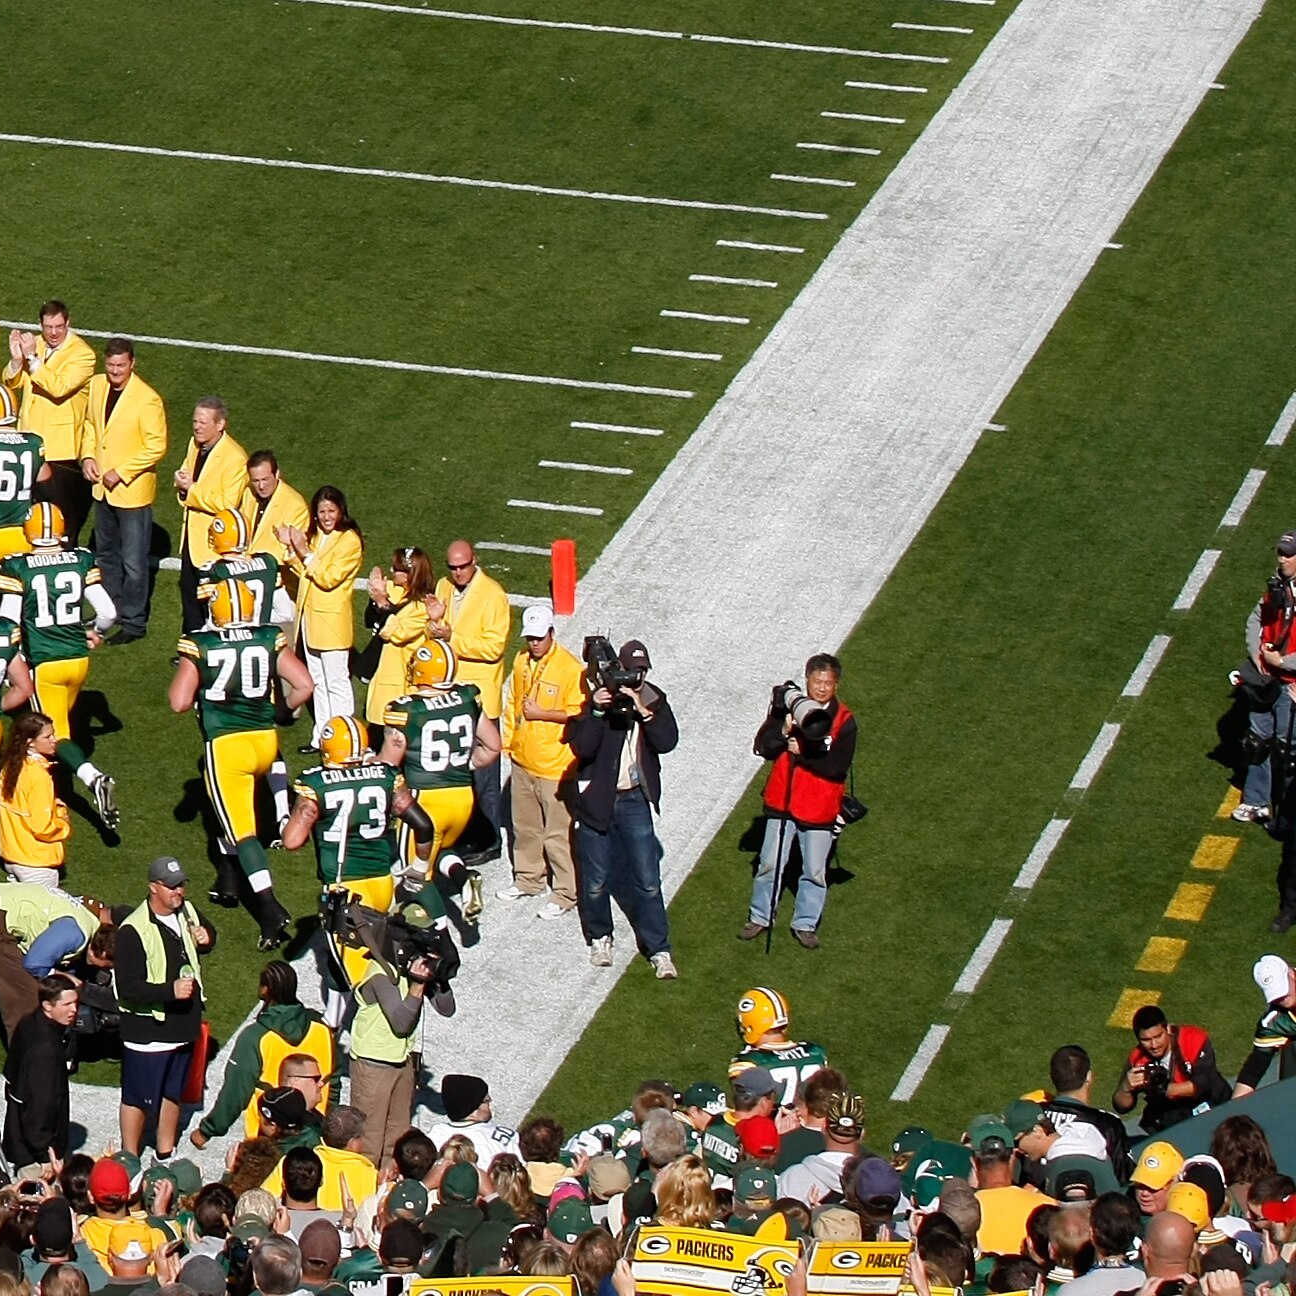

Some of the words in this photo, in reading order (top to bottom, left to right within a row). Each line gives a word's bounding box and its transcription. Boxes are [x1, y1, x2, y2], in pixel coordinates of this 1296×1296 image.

[27, 551, 78, 569] RODGERS
[31, 570, 81, 628] 12
[219, 626, 253, 642] LANG
[207, 645, 270, 702] 70
[420, 717, 474, 773] 63
[321, 765, 386, 784] COLLEDGE
[322, 785, 388, 841] 73
[676, 1239, 734, 1261] PACKERS
[870, 1252, 909, 1270] PACKE
